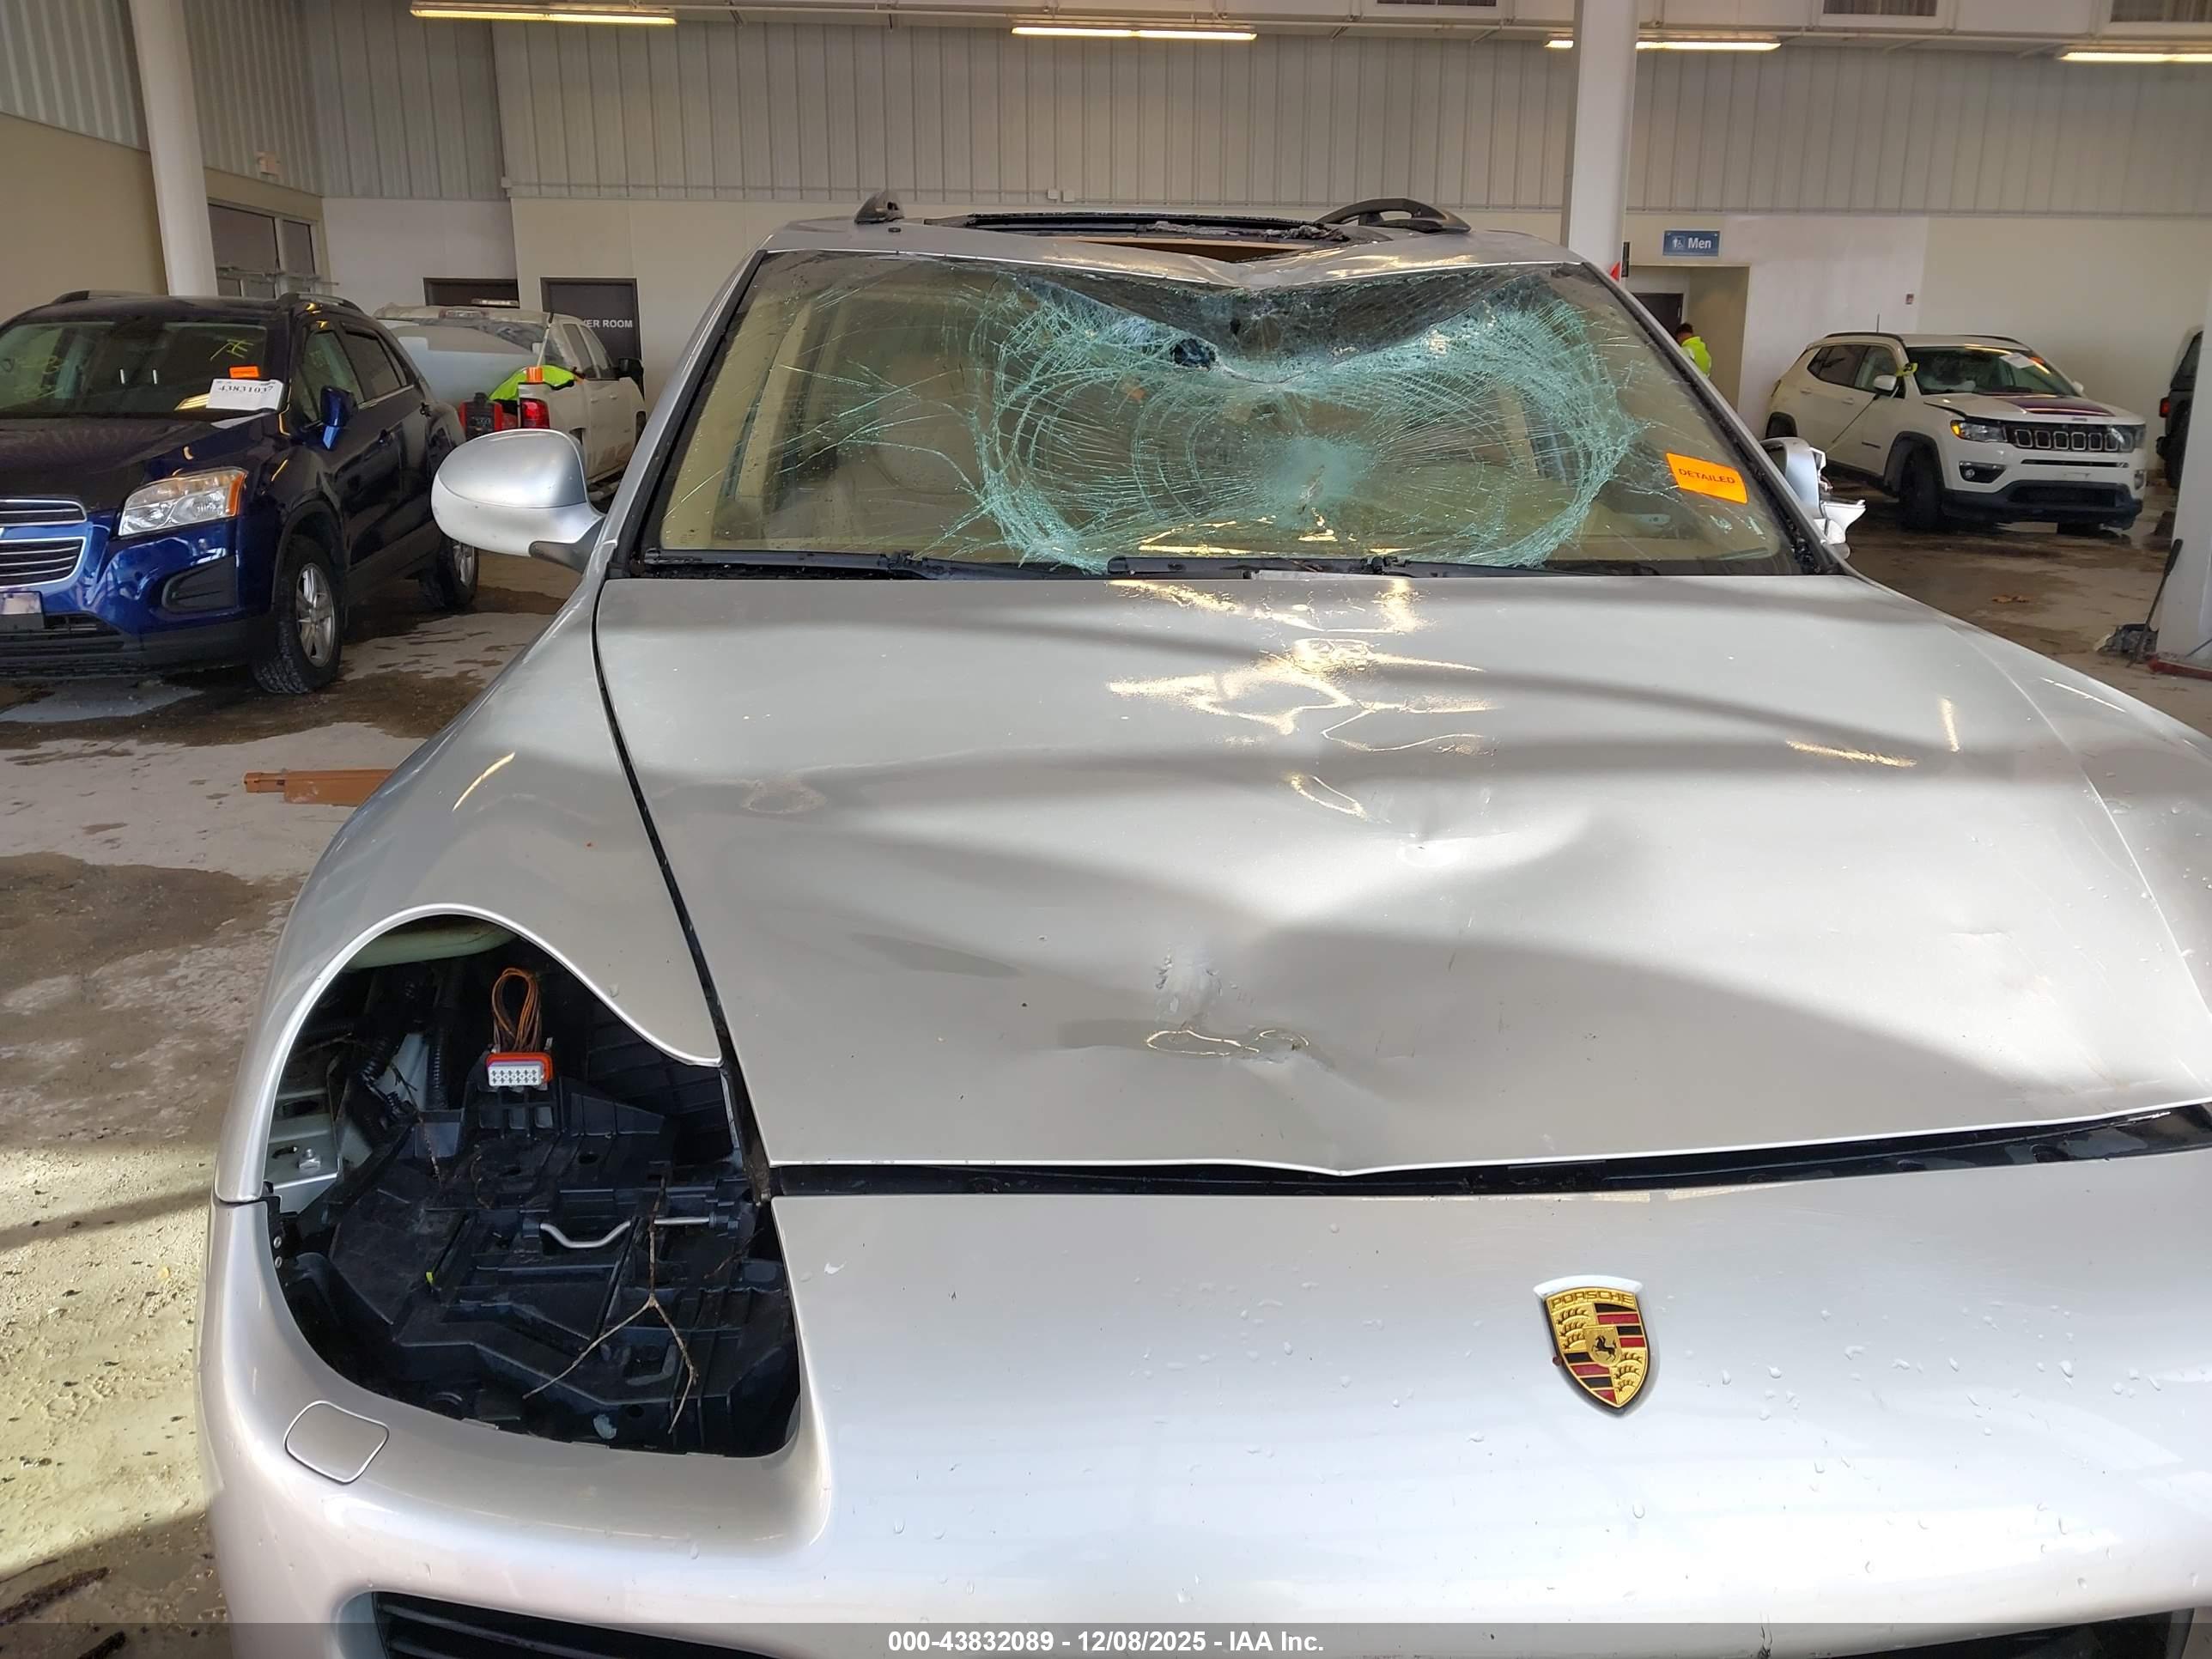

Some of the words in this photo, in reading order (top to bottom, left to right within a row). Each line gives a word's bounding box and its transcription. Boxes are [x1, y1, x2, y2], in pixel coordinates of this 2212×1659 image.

[1687, 237, 1712, 249] Men
[584, 319, 599, 328] ER
[603, 319, 633, 328] ROOM
[1678, 468, 1735, 484] DETAILED
[1551, 1290, 1635, 1310] PORSCHE
